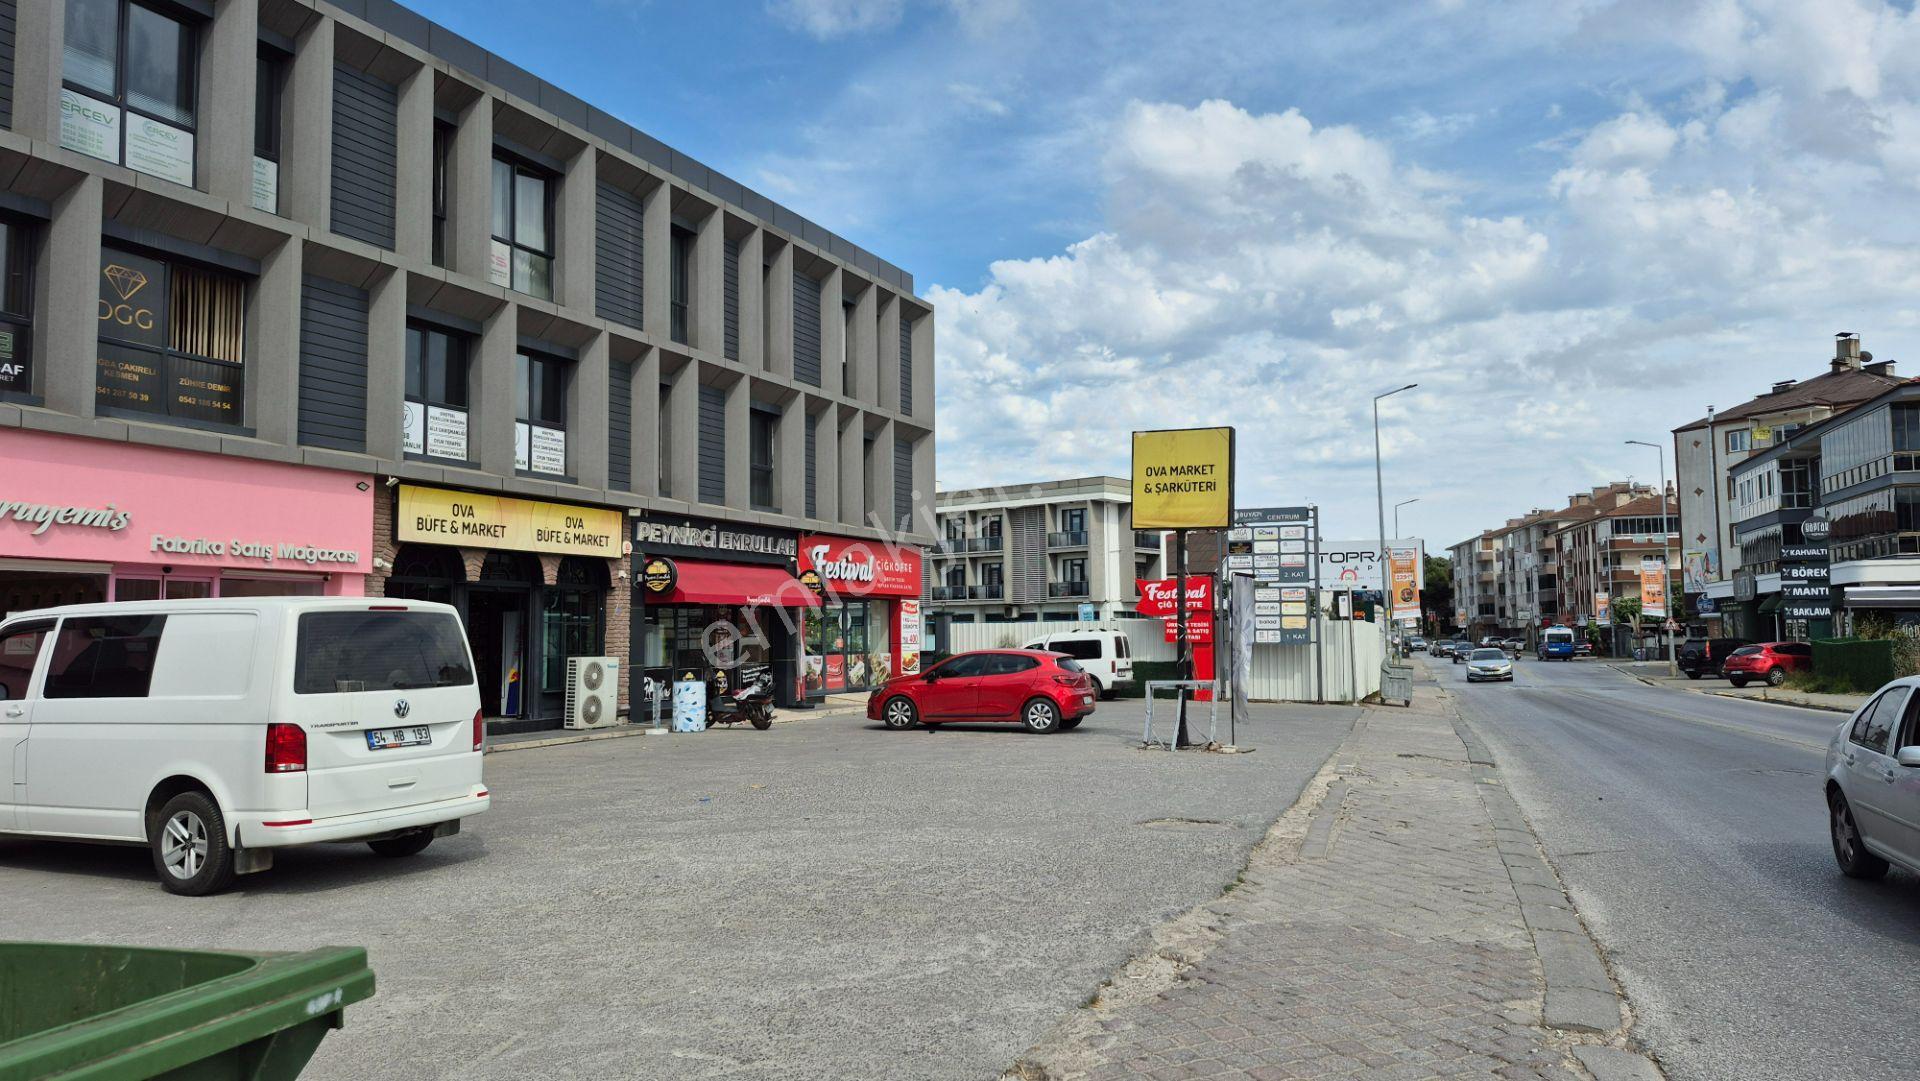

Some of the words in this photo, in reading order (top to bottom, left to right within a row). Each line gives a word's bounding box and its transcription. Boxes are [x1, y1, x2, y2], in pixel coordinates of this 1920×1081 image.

[1146, 466, 1168, 477] OVA
[1170, 464, 1215, 476] MARKET
[1144, 483, 1152, 494] &
[1155, 478, 1216, 496] ŞARKÜTERİ
[452, 503, 475, 519] OVA
[416, 514, 447, 533] BÜFE
[450, 520, 460, 535] &
[462, 521, 507, 539] MARKET
[565, 515, 584, 530] OVA
[537, 526, 562, 543] BÜFE
[564, 530, 571, 545] &
[574, 532, 610, 548] MARKET
[636, 521, 717, 548] PEYNİRCİ
[719, 531, 797, 556] EMRULLAH
[151, 534, 225, 556] Fabrika
[230, 539, 273, 562] Satış
[277, 542, 359, 565] Mağazası
[811, 544, 875, 582] Festival
[1792, 566, 1828, 578] BÖREK
[1144, 582, 1207, 602] Festval
[1792, 587, 1830, 596] MANTI
[1793, 608, 1831, 616] BAKLAVA
[374, 731, 387, 744] 54
[392, 730, 405, 742] HB
[412, 728, 429, 740] 193
